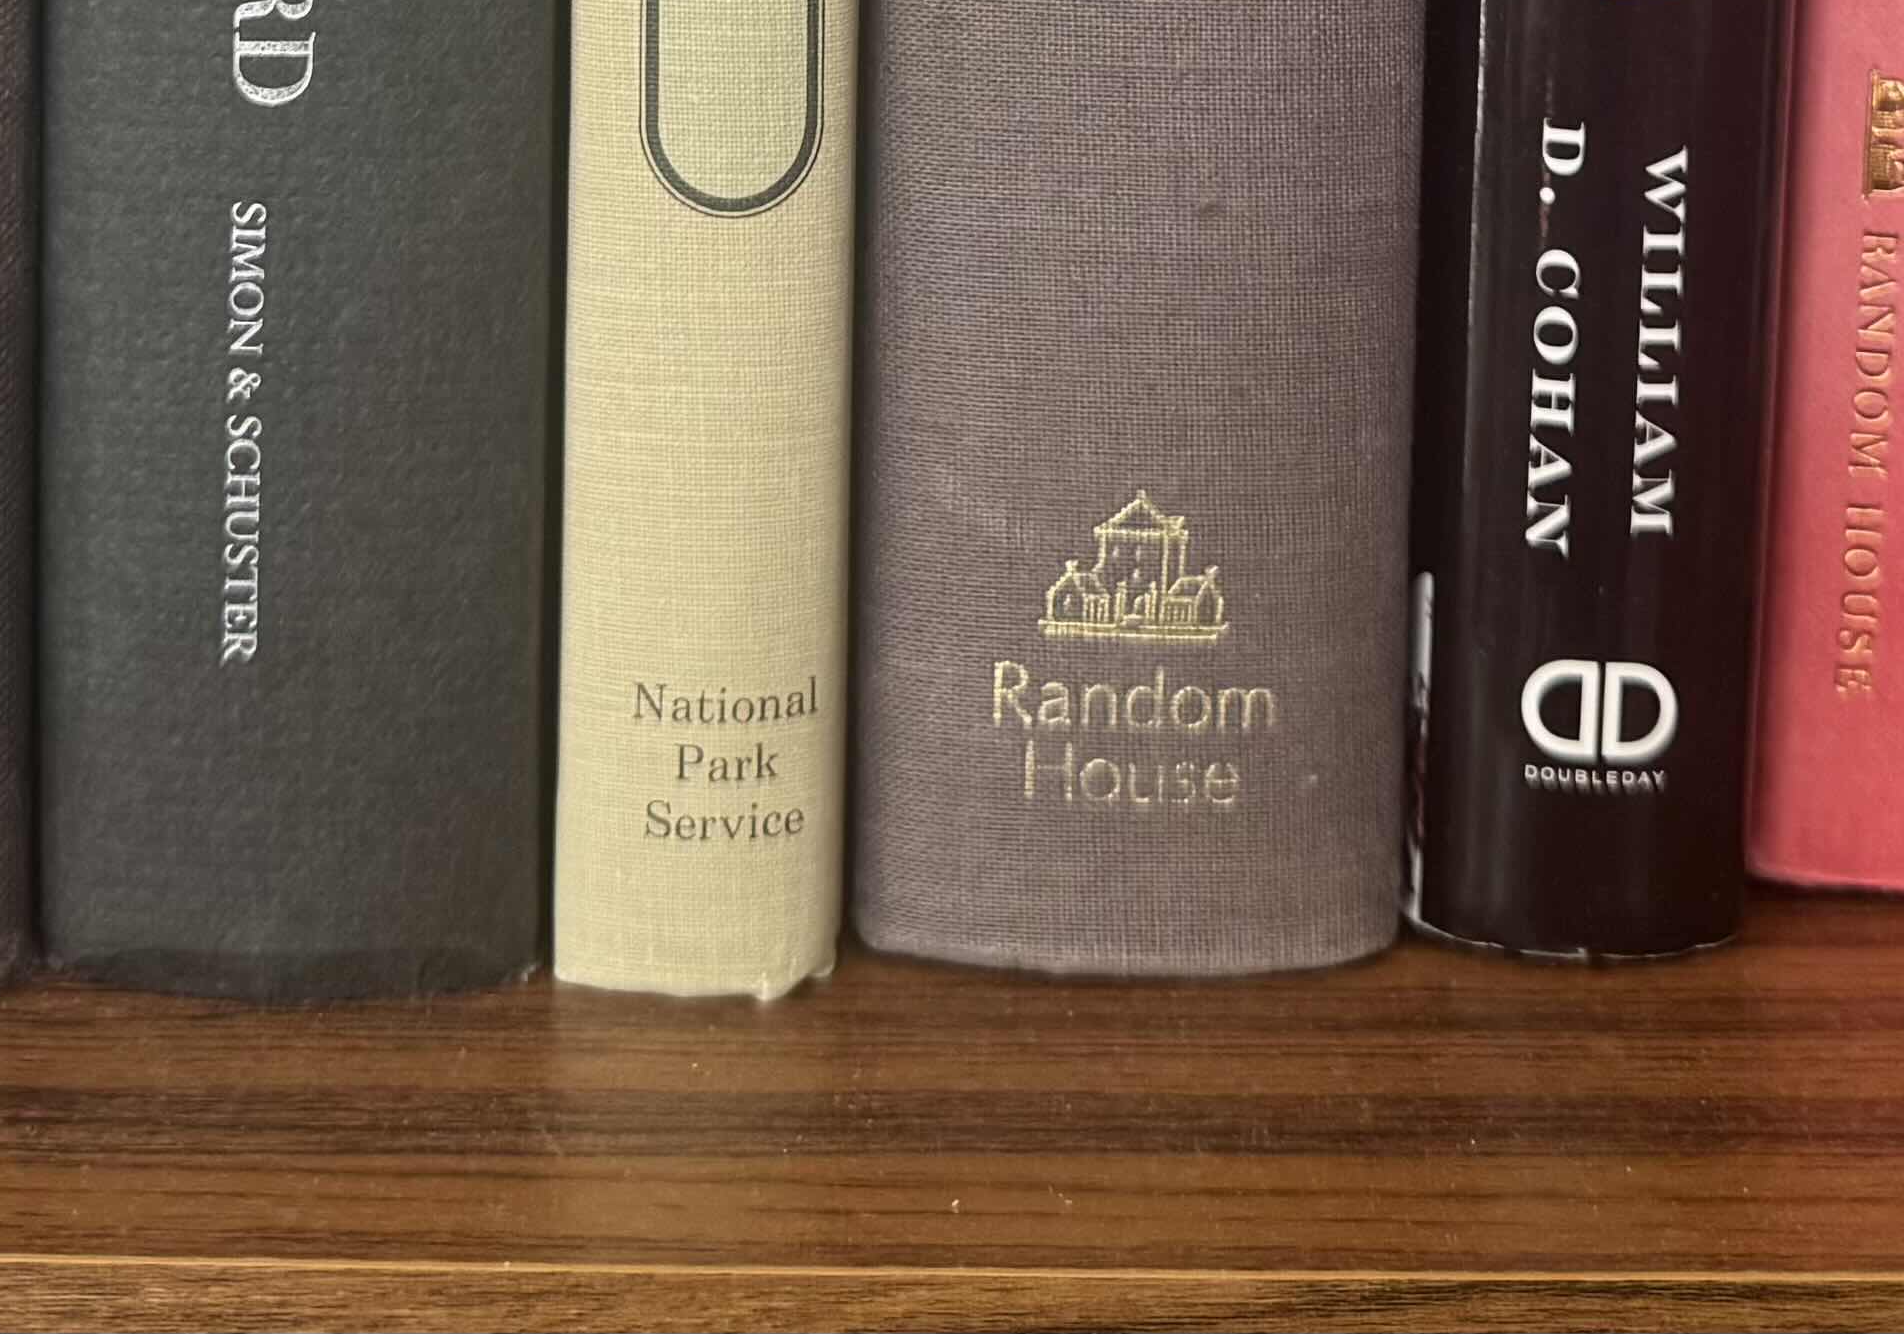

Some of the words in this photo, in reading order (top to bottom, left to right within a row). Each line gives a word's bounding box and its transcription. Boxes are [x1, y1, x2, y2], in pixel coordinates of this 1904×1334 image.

[1538, 117, 1586, 204] D.
[228, 200, 267, 357] SIMON
[1630, 144, 1690, 538] WILLIAM
[1848, 232, 1903, 478] RANDOM
[225, 366, 263, 404] &
[1525, 248, 1582, 560] COHAN
[220, 413, 263, 665] SCHUSTER
[1836, 506, 1892, 694] HOUSE
[632, 675, 818, 724] National
[992, 659, 1275, 731] Random
[674, 742, 779, 782] Park
[1023, 737, 1242, 804] House
[1524, 764, 1666, 789] DOUBLEDAY
[645, 799, 805, 841] Service
